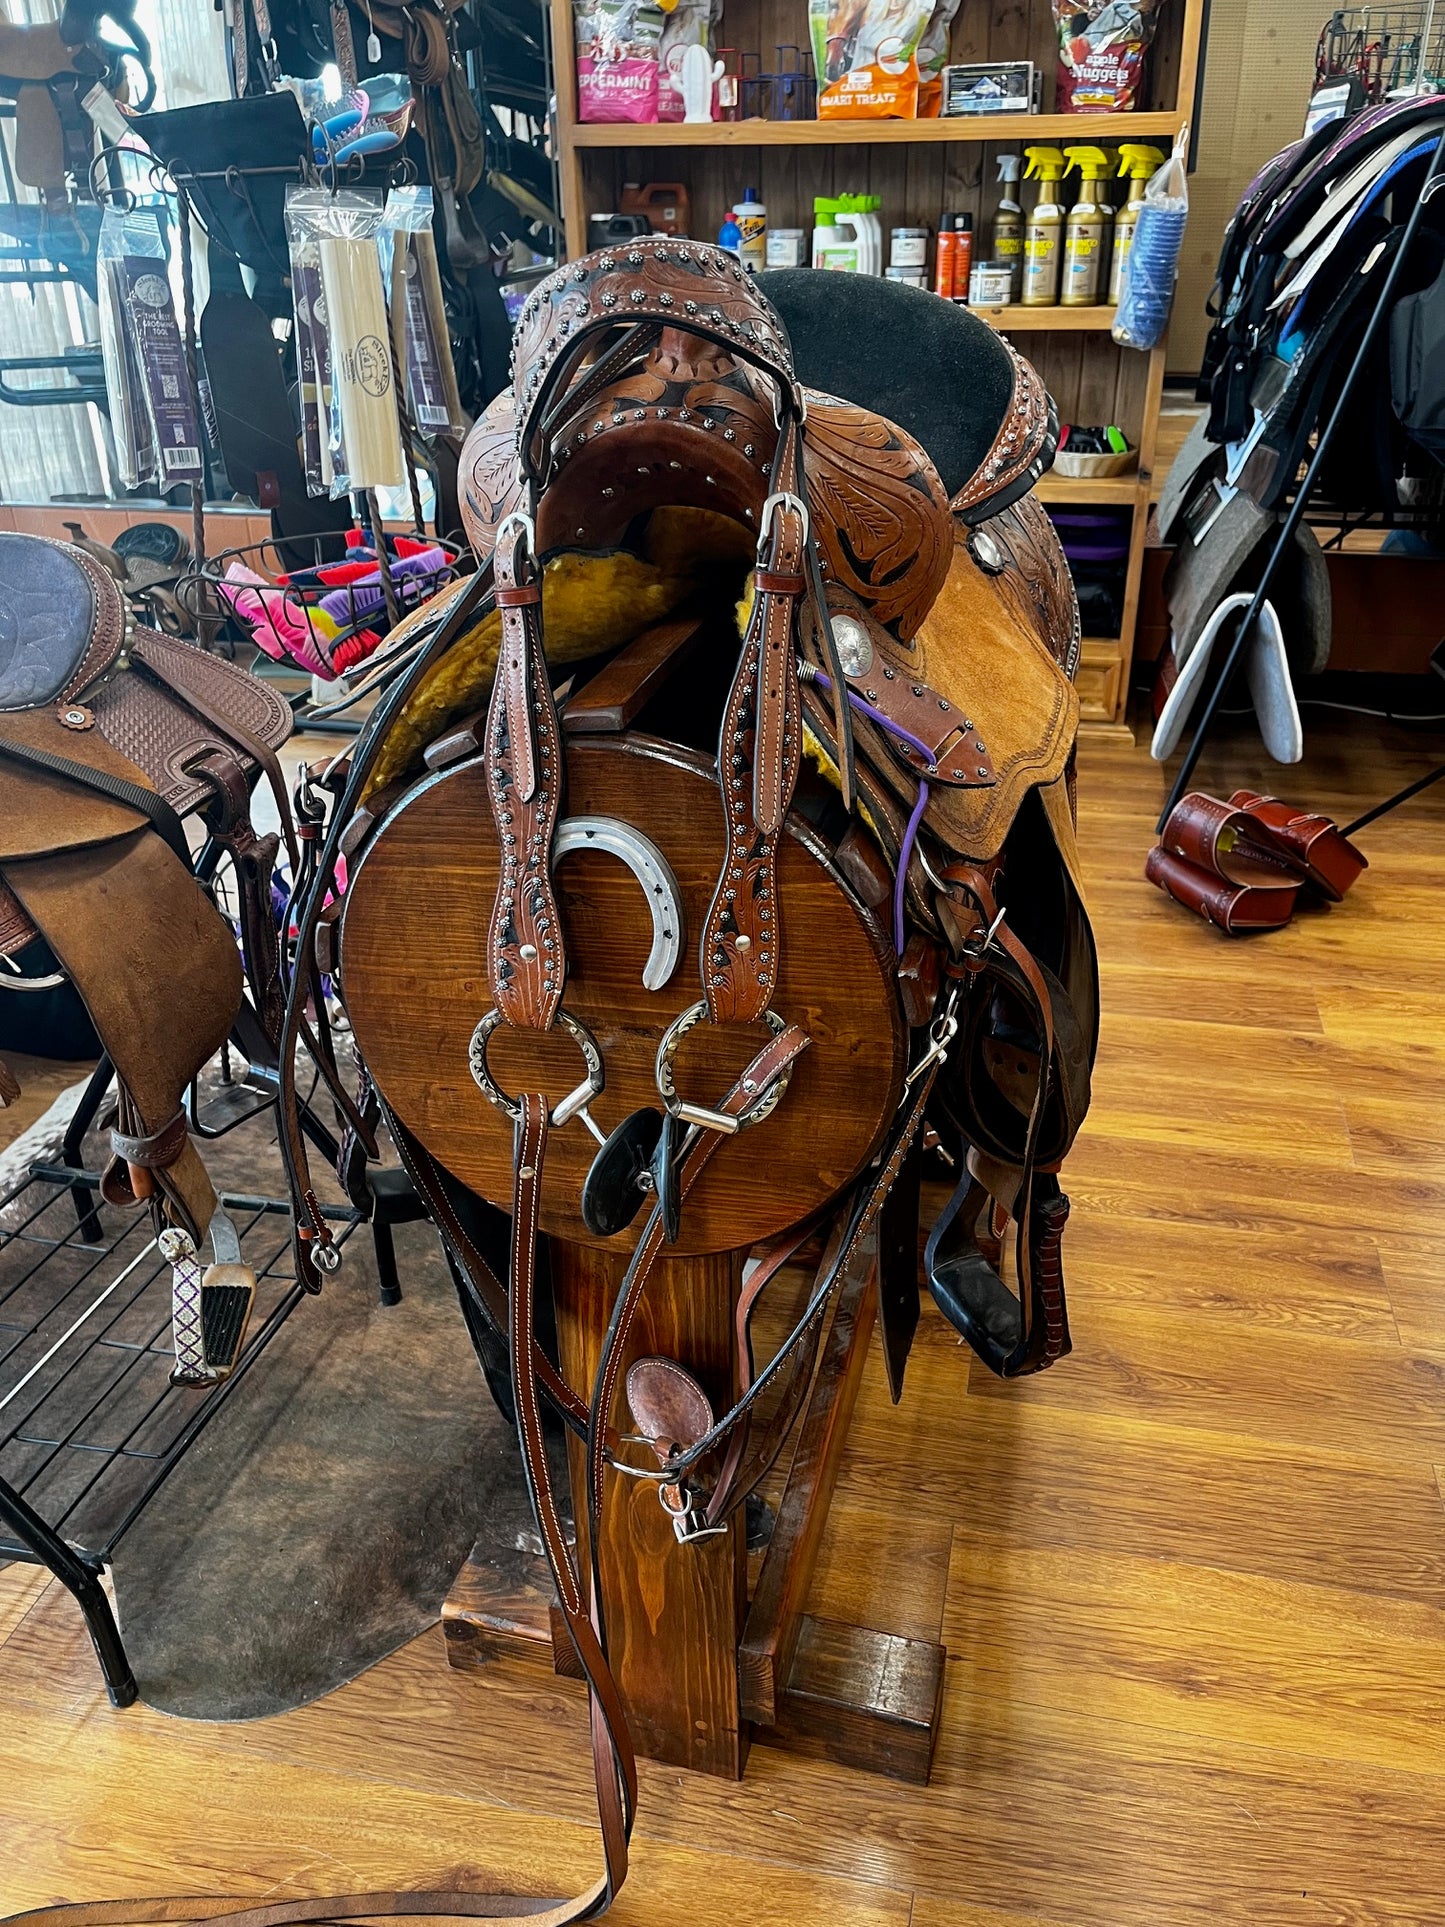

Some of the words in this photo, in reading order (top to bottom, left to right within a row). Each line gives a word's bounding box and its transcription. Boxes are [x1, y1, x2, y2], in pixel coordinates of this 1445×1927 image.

[1086, 53, 1119, 66] apple
[579, 73, 652, 91] EPPERMINT
[1071, 64, 1129, 87] Nuggets
[856, 92, 897, 105] TREATS
[153, 328, 169, 336] TOOL
[371, 340, 388, 395] SleekEZ
